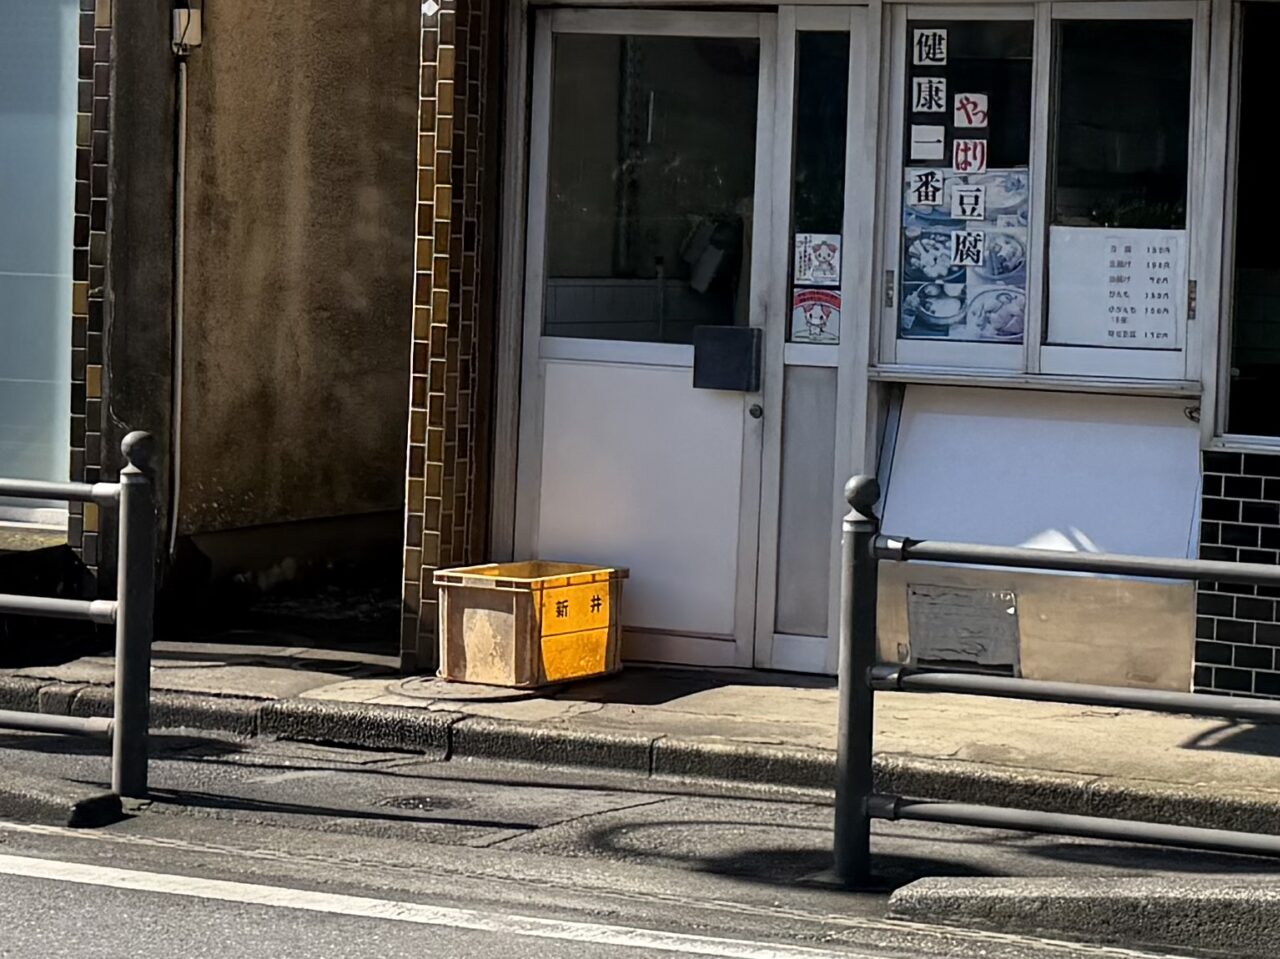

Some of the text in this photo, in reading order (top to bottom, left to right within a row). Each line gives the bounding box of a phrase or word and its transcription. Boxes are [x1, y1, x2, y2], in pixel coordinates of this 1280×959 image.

[912, 31, 945, 203] 健康一番
[555, 594, 603, 618] 新井
